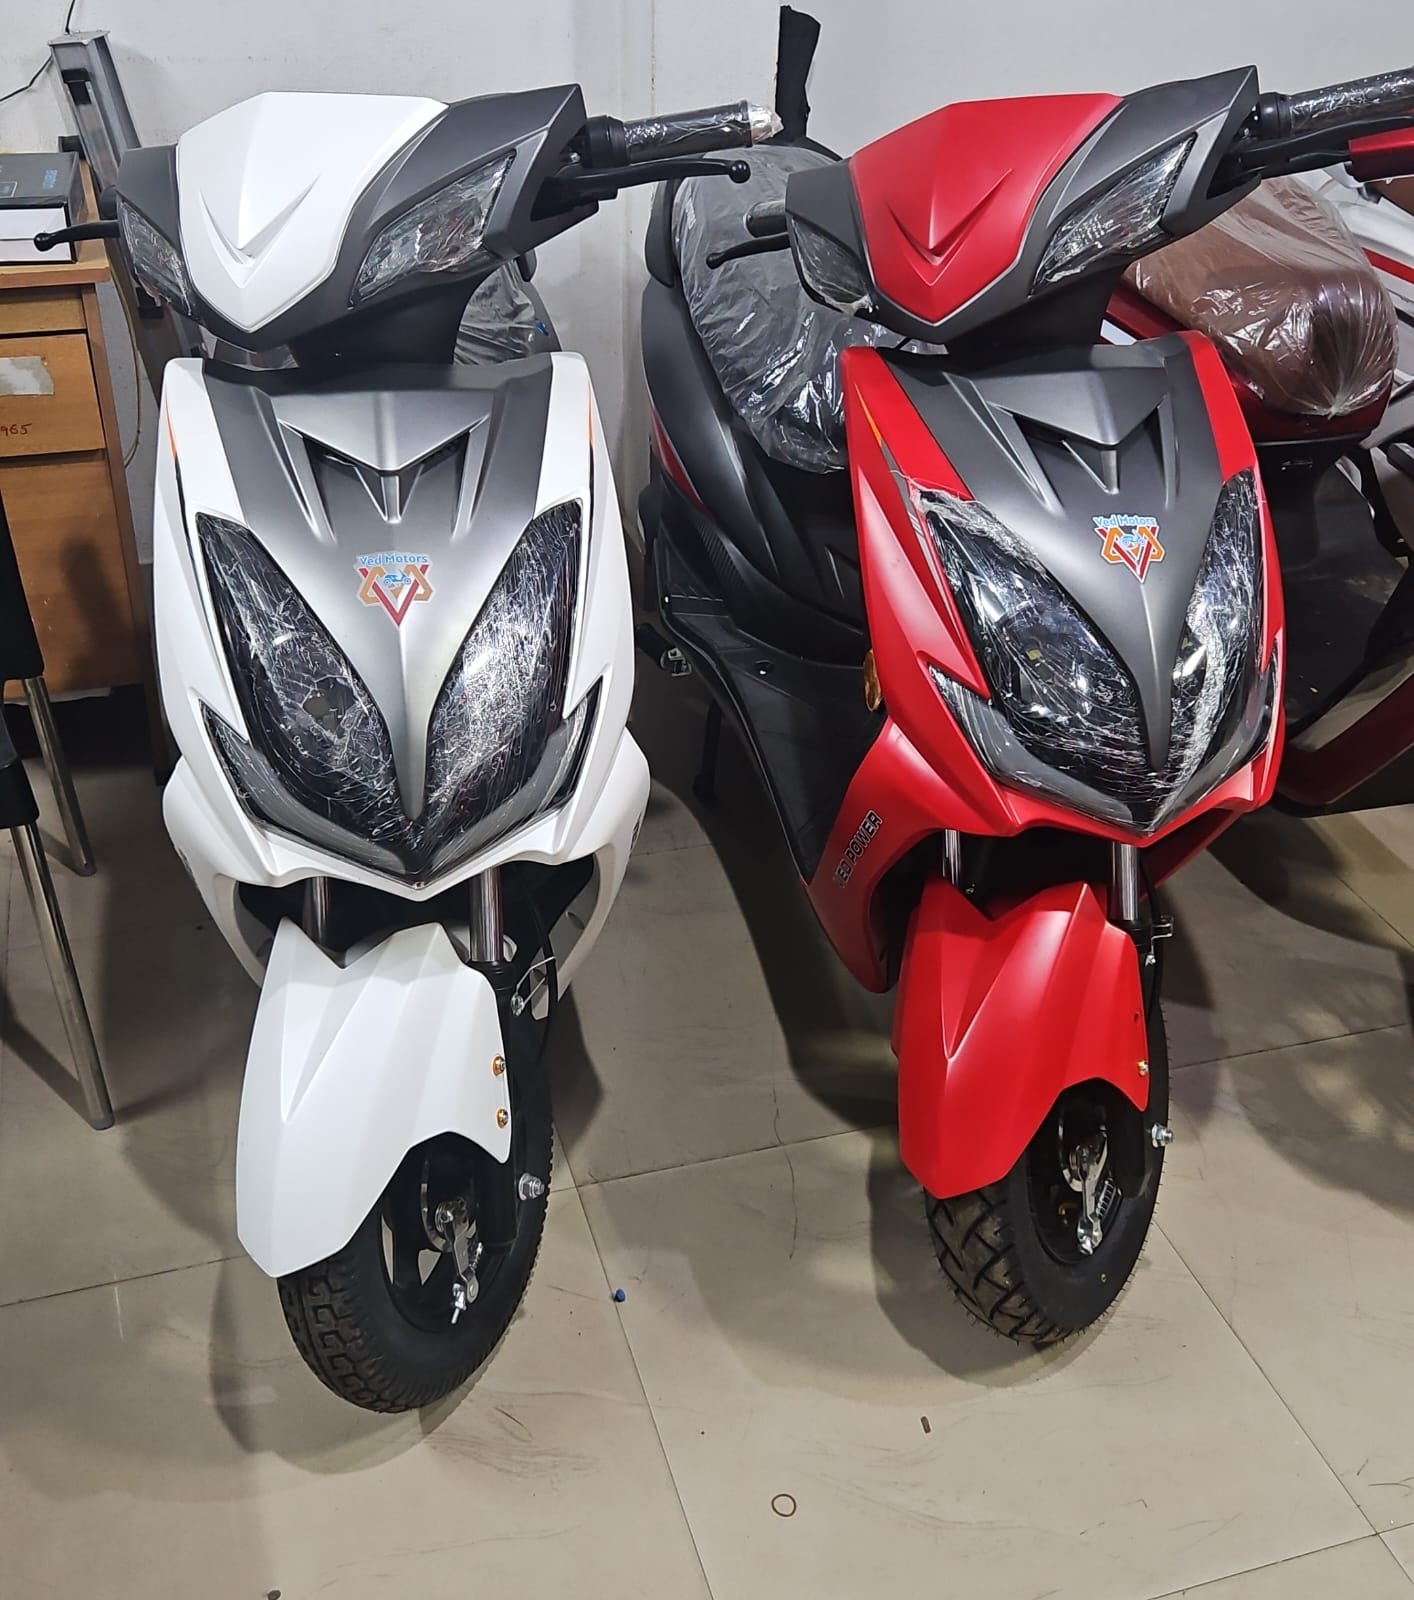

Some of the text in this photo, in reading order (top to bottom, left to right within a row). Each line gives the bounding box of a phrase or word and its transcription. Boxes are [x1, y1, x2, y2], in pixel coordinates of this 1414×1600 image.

[1095, 514, 1156, 526] Ved Motors
[359, 553, 428, 566] Ved Motors
[844, 809, 883, 866] POWER
